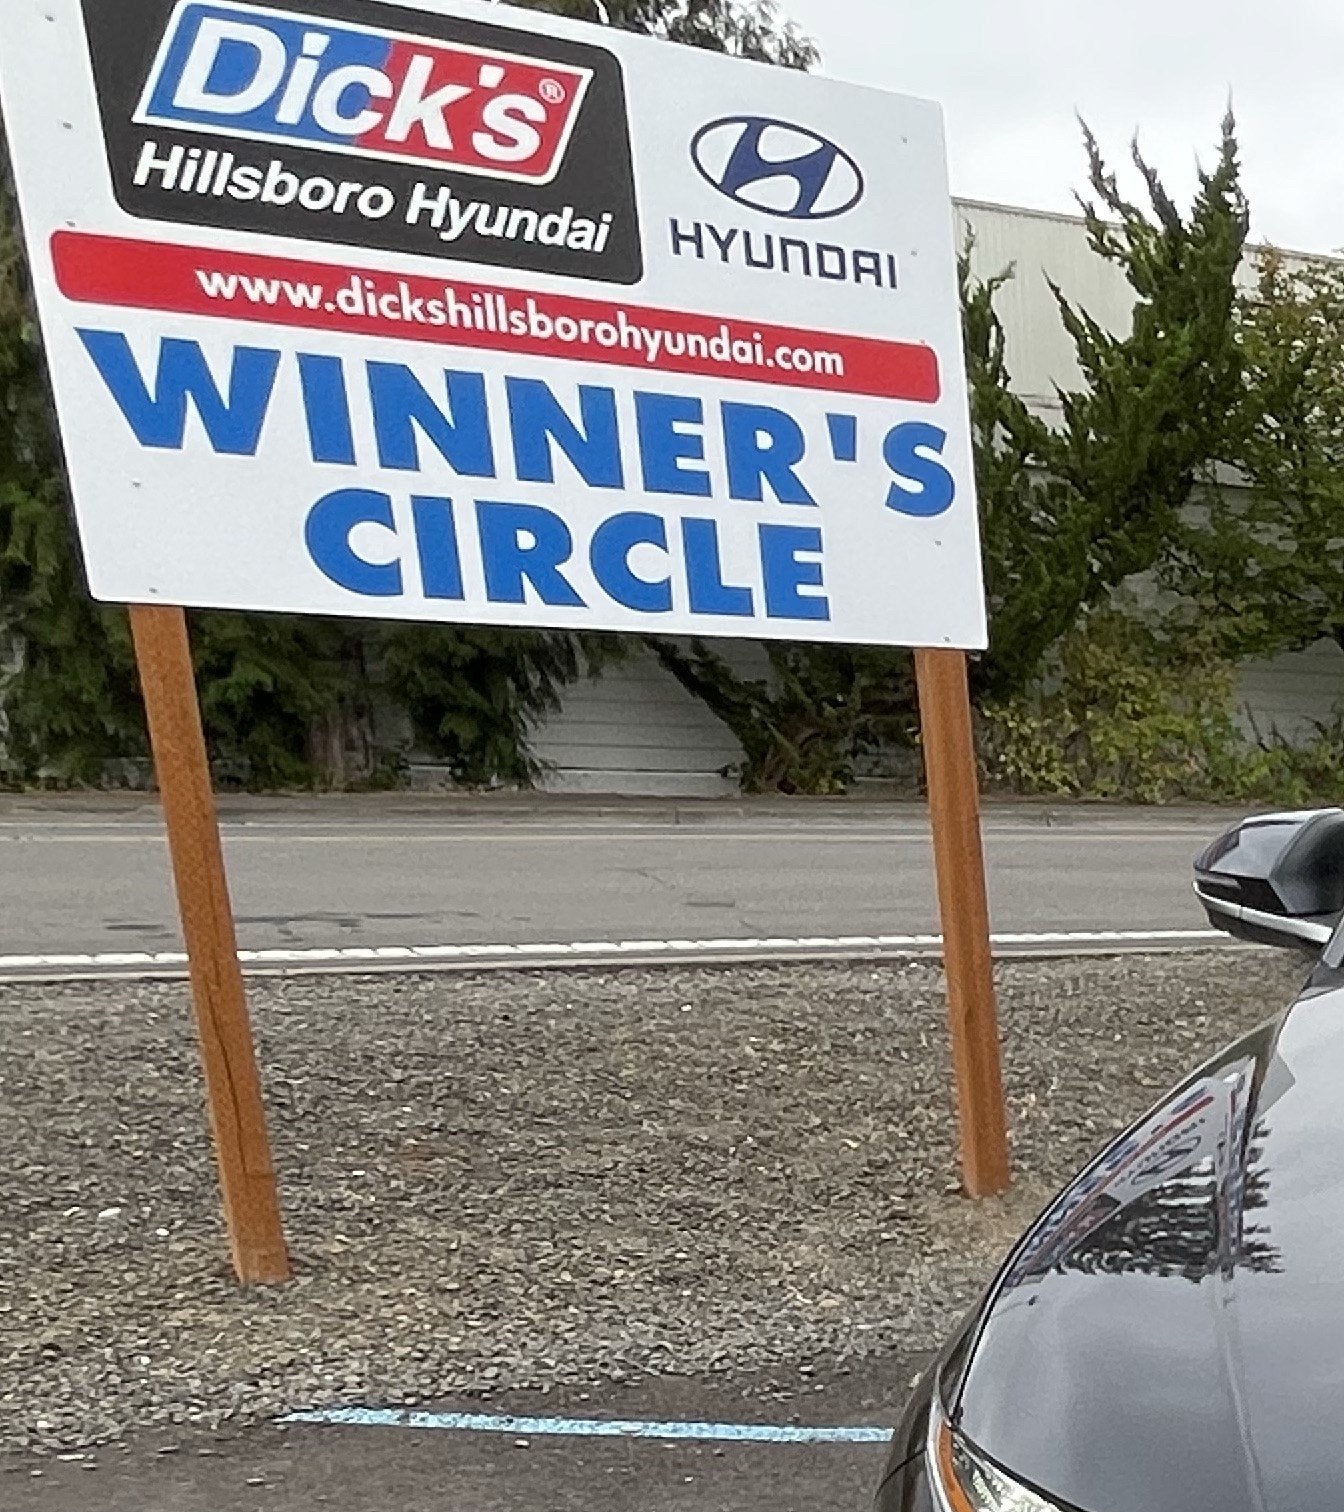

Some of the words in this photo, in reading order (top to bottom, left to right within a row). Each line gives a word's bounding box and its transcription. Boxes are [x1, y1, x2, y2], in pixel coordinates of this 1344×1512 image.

[132, 141, 396, 219] Hillsboro
[405, 183, 614, 254] Hyundai
[670, 218, 898, 290] HYUNDAI
[194, 267, 846, 378] www.dickshillsborohyundai.com
[73, 325, 957, 519] WINNER'S
[303, 486, 832, 622] CIRCLE
